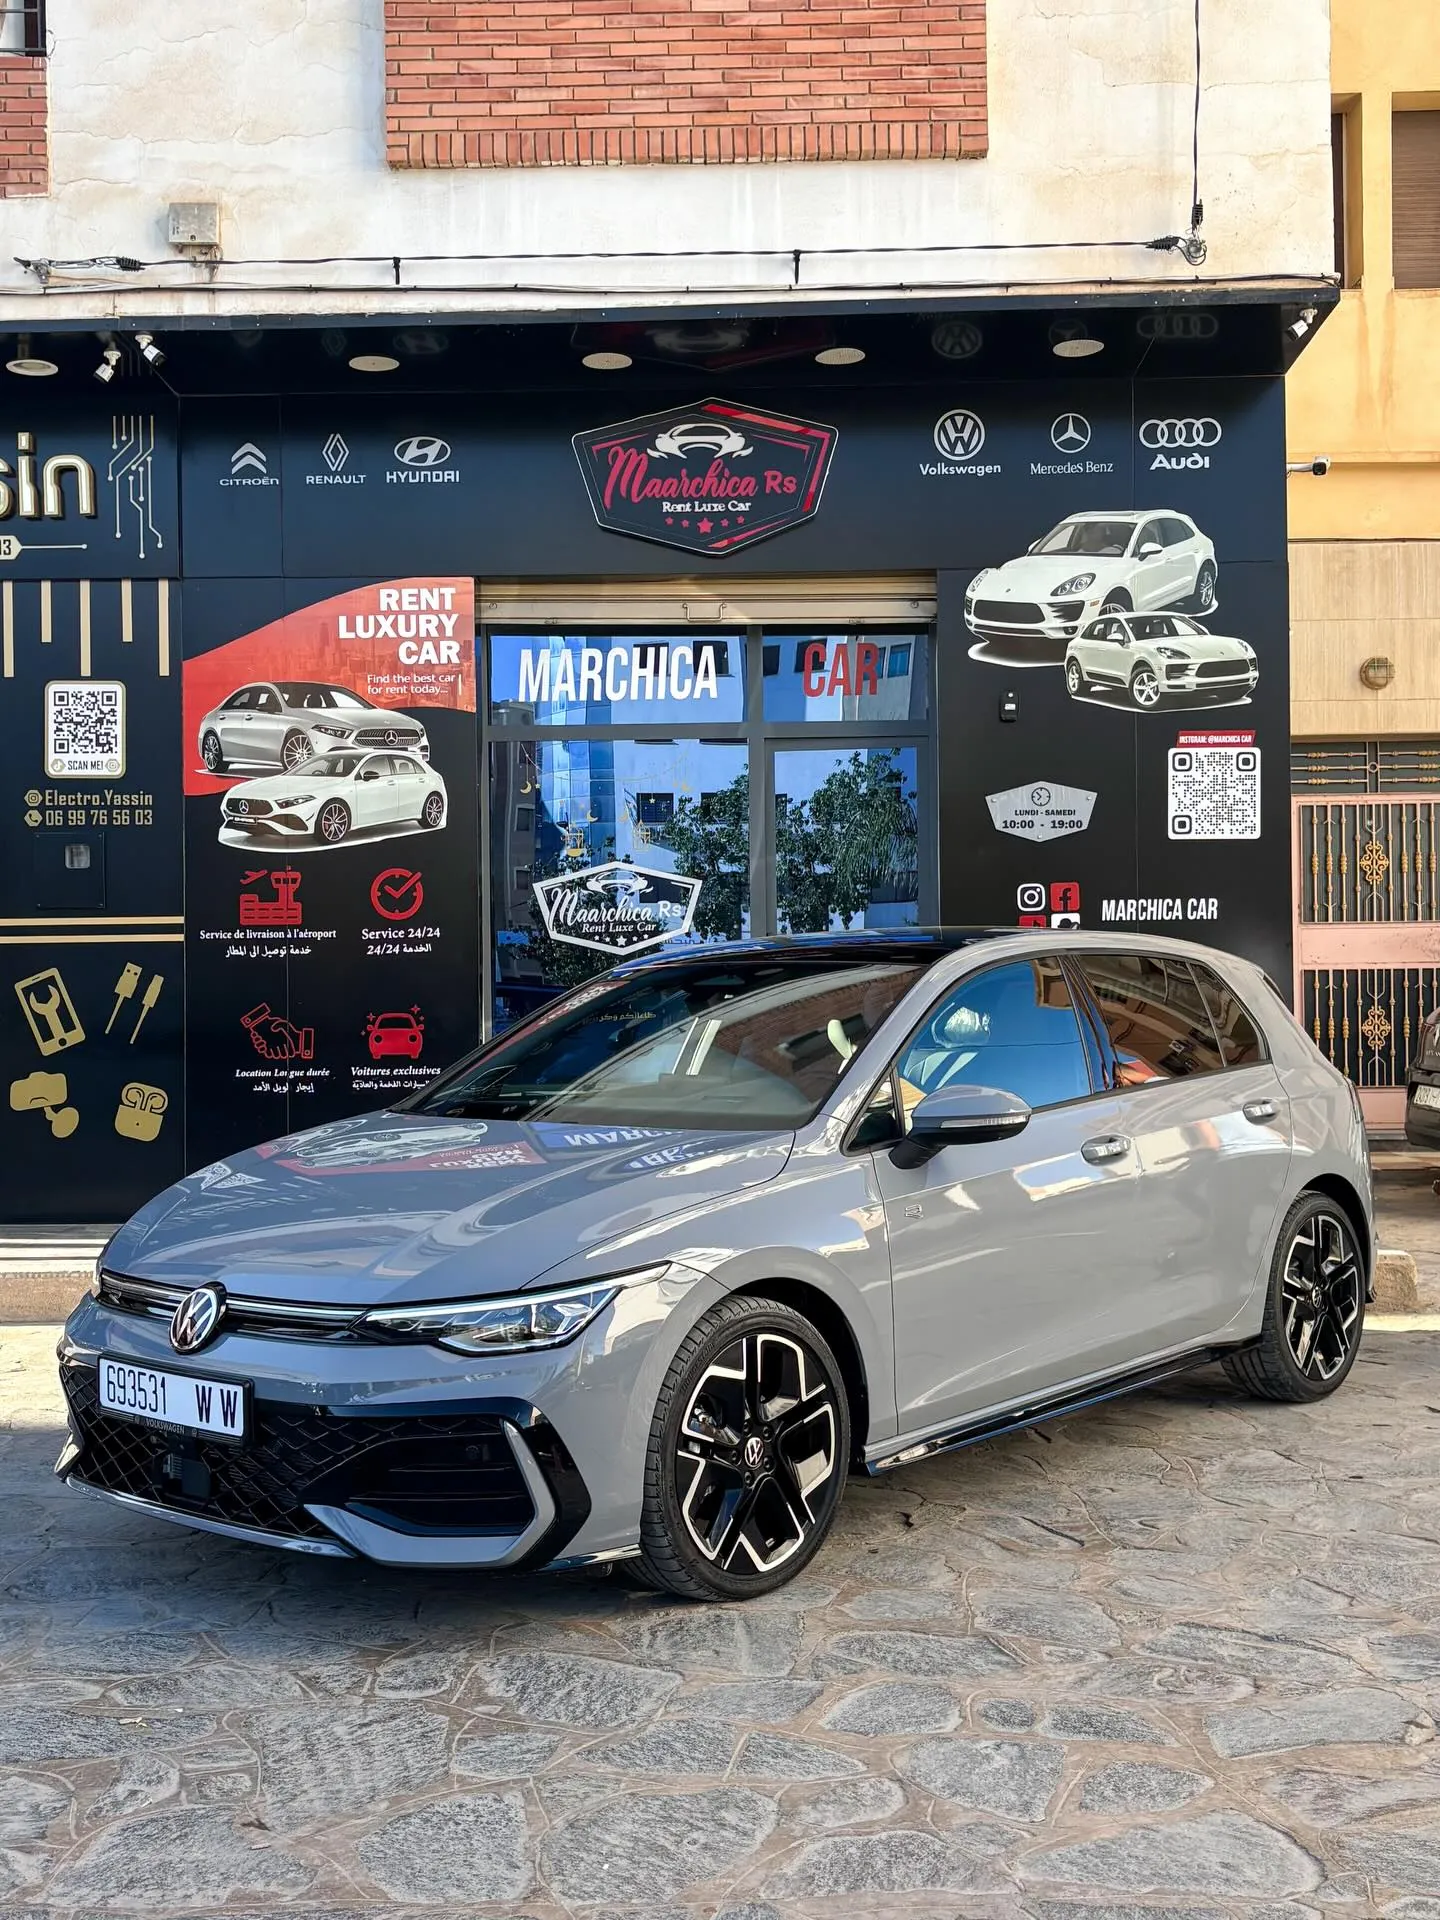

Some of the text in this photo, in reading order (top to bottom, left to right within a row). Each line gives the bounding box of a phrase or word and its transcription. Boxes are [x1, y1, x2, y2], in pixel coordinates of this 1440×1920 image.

[1030, 461, 1113, 475] Mercedes Benz
[1150, 453, 1210, 470] Audi
[920, 463, 1001, 476] Volkswagen
[219, 477, 279, 486] CITROËN
[306, 475, 366, 484] RENAULT
[386, 470, 459, 483] HYUNDAI
[604, 446, 758, 510] Maarchica
[662, 500, 751, 513] Rent Luxe Car
[0, 539, 11, 556] 3
[380, 588, 456, 611] RENT
[338, 613, 459, 638] LUXURY
[398, 640, 460, 665] CAR
[367, 674, 455, 683] Find the best car
[518, 642, 879, 702] MARCHICA CAR
[367, 685, 382, 694] for
[386, 685, 407, 694] rent
[67, 761, 88, 770] SCAN
[45, 790, 153, 806] Electro.Yassin
[45, 809, 153, 826] 06 99 76 56 03
[1002, 820, 1034, 829] 10:00
[1050, 820, 1083, 829] 19:00
[550, 887, 652, 931] Maarchica
[1101, 898, 1218, 921] MARCHICA CAR
[200, 930, 232, 939] Service
[234, 929, 244, 939] de
[246, 929, 285, 939] livraison
[361, 926, 441, 939] Service 24/24
[582, 922, 656, 933] Rent Luxe Car
[225, 945, 312, 957] خدمة توصيل الى المطار
[366, 943, 432, 955] الخدمة 24/24
[235, 1068, 271, 1077] Location
[306, 1068, 330, 1076] durée
[351, 1065, 441, 1076] Voitures exclusives
[107, 1365, 166, 1415] 693531
[145, 1417, 185, 1435] VOLKSWAGEN
